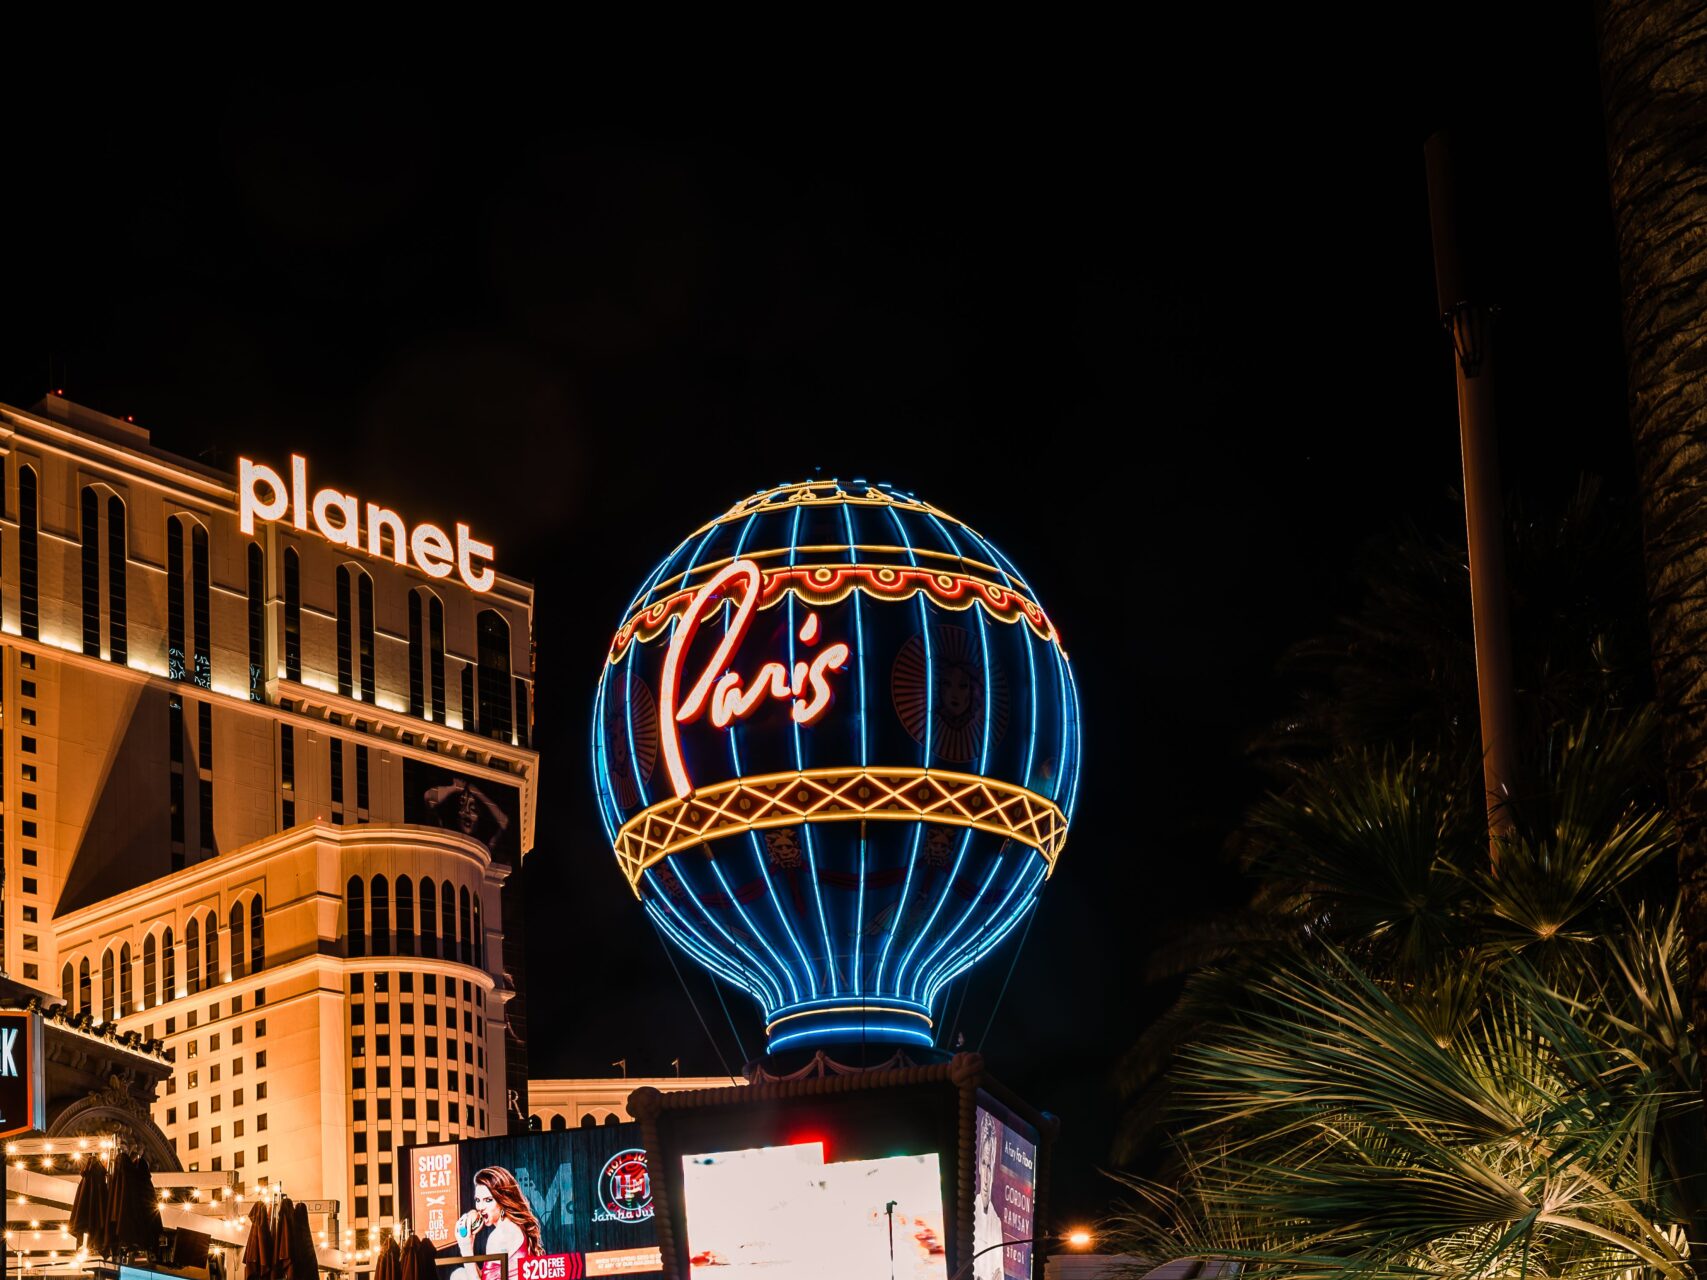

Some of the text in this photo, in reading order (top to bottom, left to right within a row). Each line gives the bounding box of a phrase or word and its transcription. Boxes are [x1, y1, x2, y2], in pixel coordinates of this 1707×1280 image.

[239, 454, 495, 592] planet
[661, 560, 849, 801] Paris
[418, 1153, 452, 1172] SHOP
[420, 1170, 451, 1188] & EAT
[1004, 1185, 1031, 1213] GORDON
[429, 1209, 444, 1220] IT'S
[1003, 1207, 1030, 1235] RAMSAY
[428, 1219, 444, 1230] OUR
[425, 1228, 448, 1241] TREAT
[522, 1259, 548, 1280] $20
[547, 1256, 566, 1268] FREE
[548, 1267, 566, 1278] EATS
